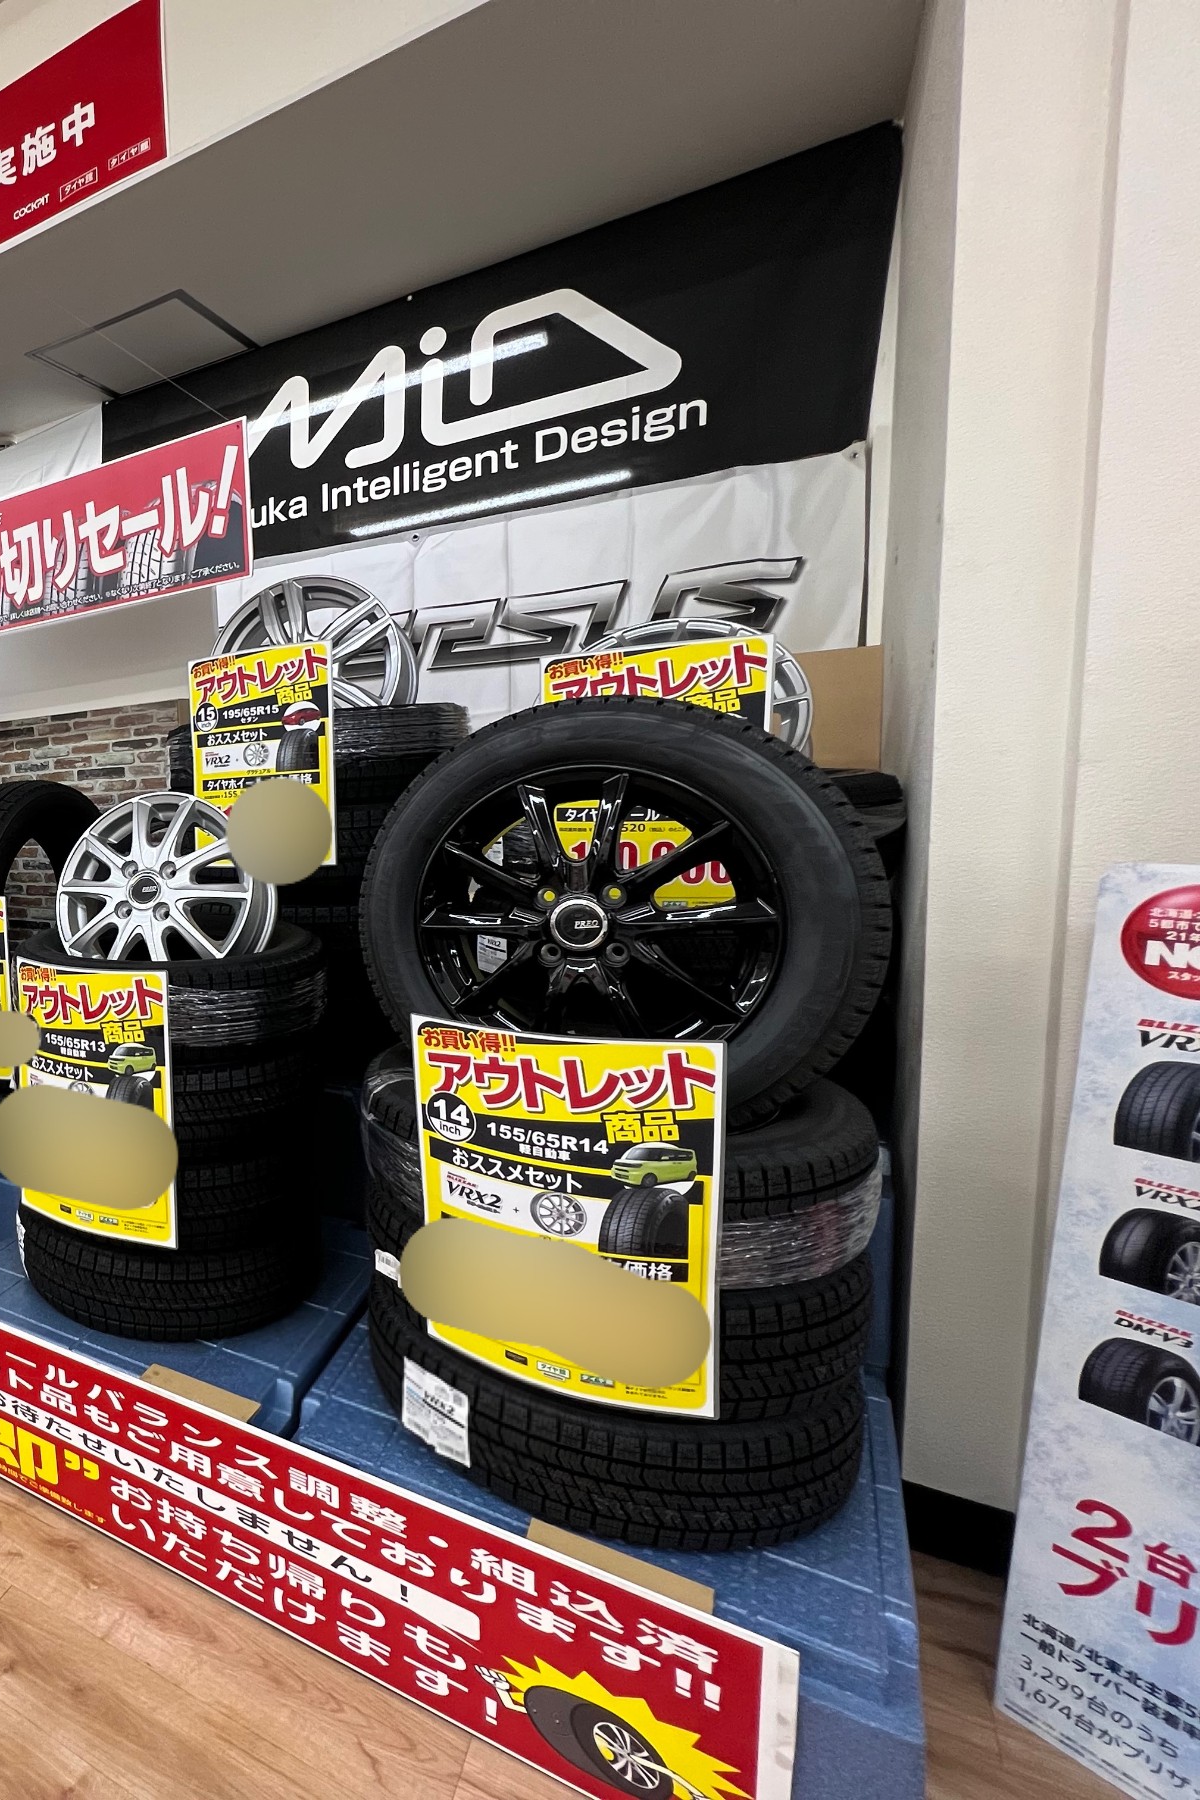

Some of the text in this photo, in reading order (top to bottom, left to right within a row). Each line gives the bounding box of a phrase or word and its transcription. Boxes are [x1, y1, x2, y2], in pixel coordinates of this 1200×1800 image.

[13, 193, 50, 220] COCKPIT
[250, 398, 708, 529] uka Intelligent Design
[195, 647, 328, 704] アウトレット
[549, 651, 624, 681] お買い得!!
[552, 644, 768, 700] アウトレット
[275, 682, 313, 706] 商品
[199, 706, 216, 722] 15
[222, 704, 280, 720] 195/65R15
[206, 728, 268, 747] おススメセット
[204, 754, 231, 768] VRX2
[22, 978, 164, 1023] アウトレット
[102, 1021, 145, 1045] 商品
[422, 1027, 517, 1053] お買い得!!
[1137, 1018, 1200, 1034] BLIZ
[44, 1031, 107, 1054] 155/65R13
[1138, 1029, 1200, 1053] VR
[31, 1054, 94, 1082] おススメセット
[427, 1051, 716, 1110] アウトレット
[432, 1098, 471, 1127] 14
[439, 1120, 462, 1138] inch
[486, 1121, 610, 1156] 155/65R14
[602, 1110, 680, 1144] 商品
[518, 1143, 572, 1162] 軽自動車
[451, 1146, 583, 1194] おススメセット
[446, 1180, 503, 1209] VRX2
[1134, 1177, 1200, 1199] BLIZZA
[1113, 1317, 1194, 1349] DM-V3
[110, 1474, 468, 1672] お持ち帰りも
[1019, 1653, 1180, 1759] 3,299台のうち
